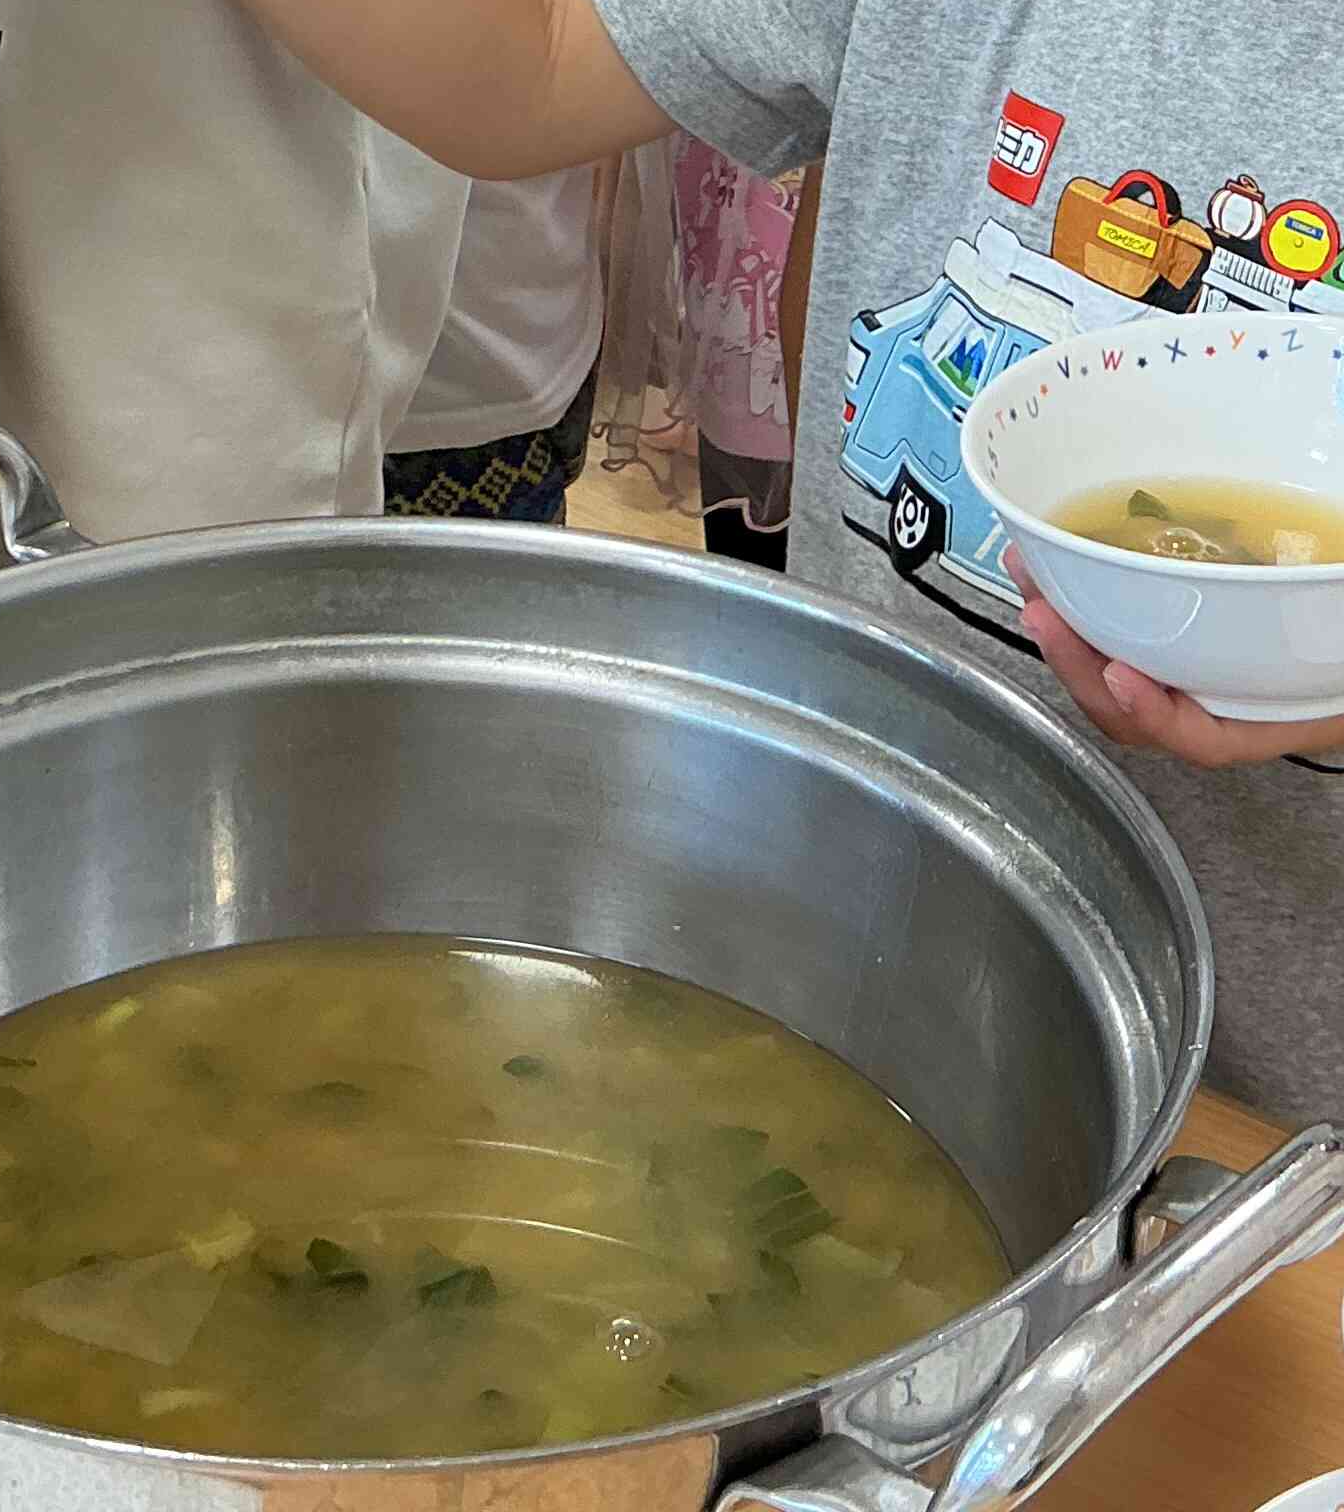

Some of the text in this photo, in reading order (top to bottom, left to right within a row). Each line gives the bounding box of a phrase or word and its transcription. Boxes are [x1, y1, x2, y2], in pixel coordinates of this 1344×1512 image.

[1102, 226, 1153, 255] TOMICA
[1057, 356, 1071, 378] V
[1102, 348, 1124, 371] W
[1164, 338, 1188, 363] X
[1281, 328, 1304, 352] Z
